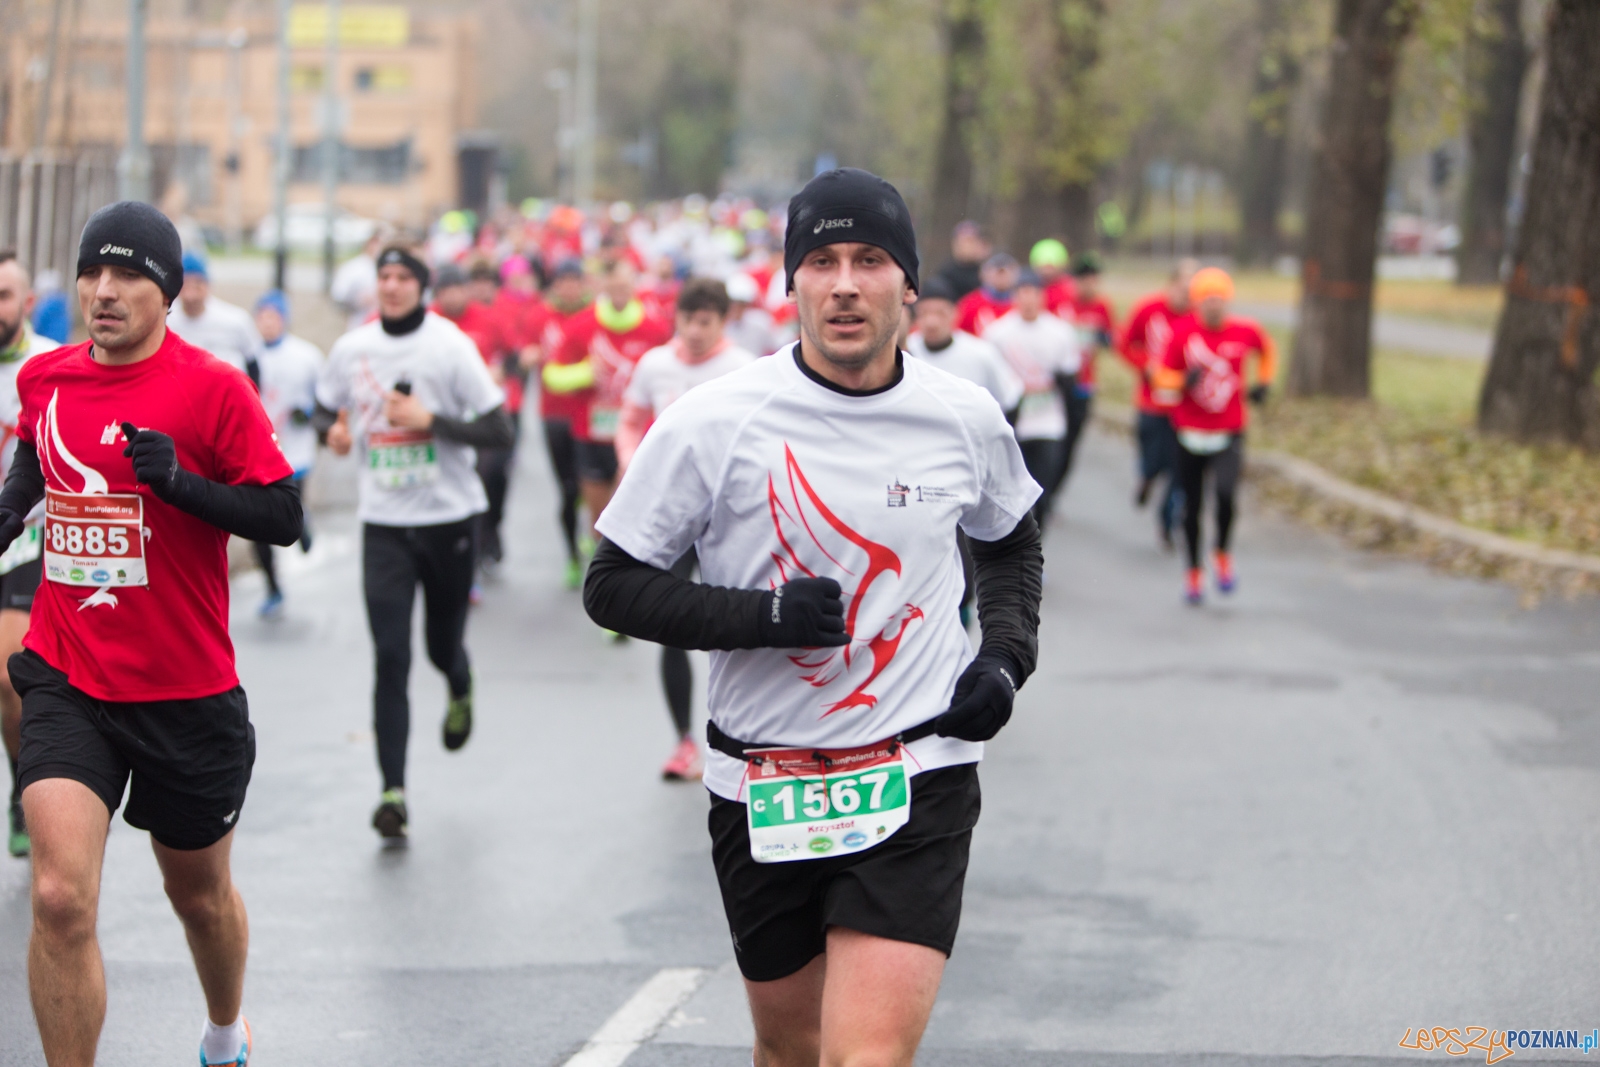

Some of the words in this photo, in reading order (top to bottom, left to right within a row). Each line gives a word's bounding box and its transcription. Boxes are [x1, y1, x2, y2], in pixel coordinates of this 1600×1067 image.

[110, 245, 134, 257] asics
[84, 505, 133, 514] RunPoland.org
[52, 523, 129, 555] 8885
[72, 559, 98, 567] Tomasz
[772, 771, 890, 821] 1567
[808, 820, 855, 833] Krzysztof
